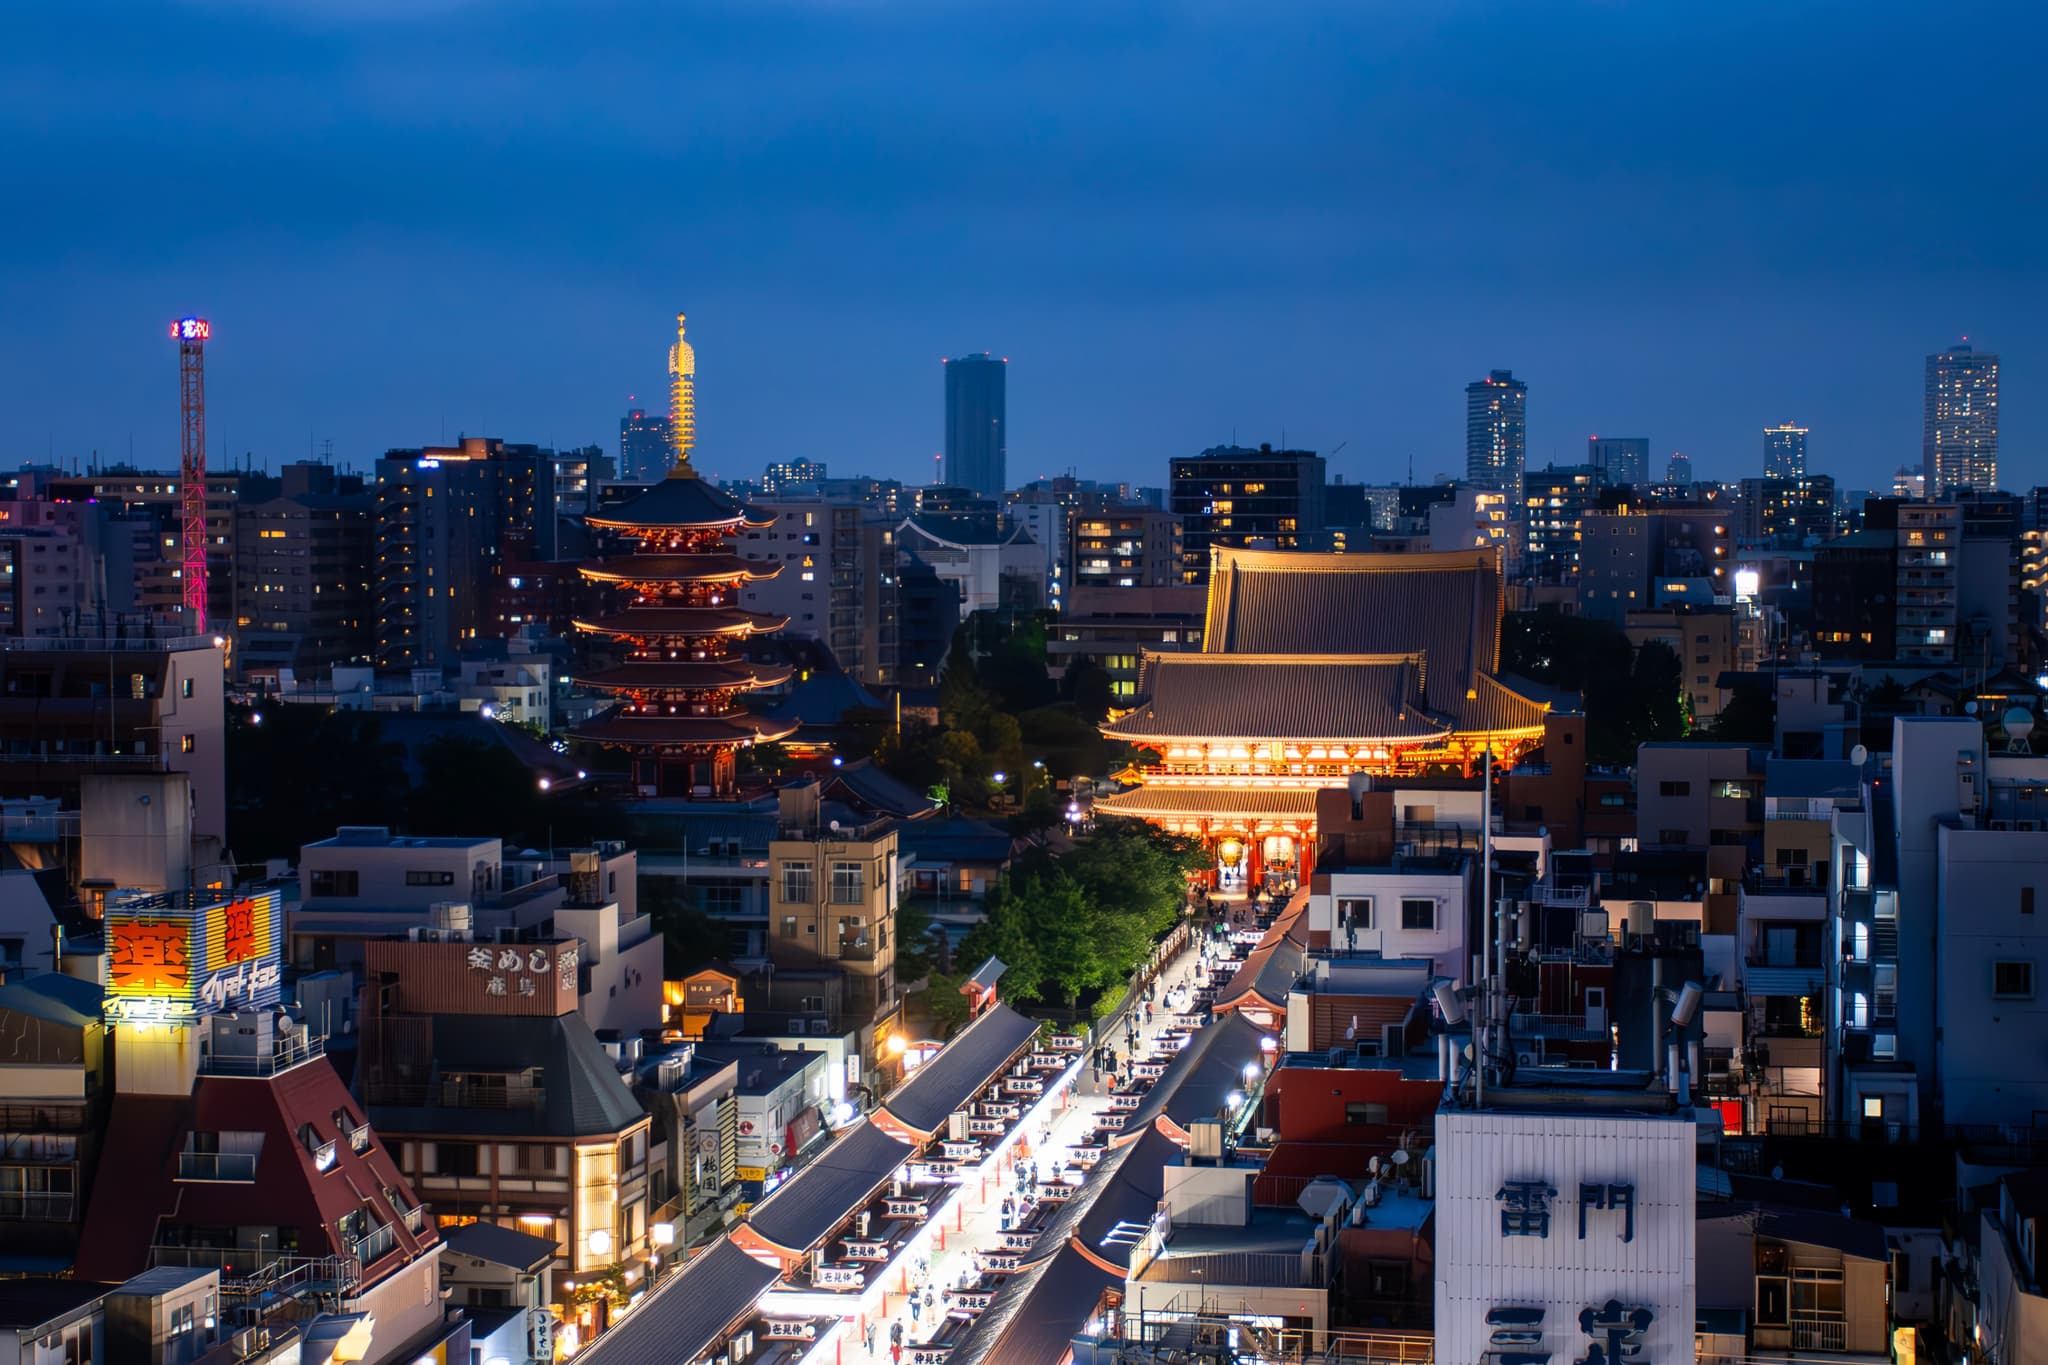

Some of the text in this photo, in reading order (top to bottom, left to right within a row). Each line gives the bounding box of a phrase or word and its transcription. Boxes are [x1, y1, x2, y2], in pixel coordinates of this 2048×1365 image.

[111, 921, 188, 989] 薬
[224, 897, 257, 963] 薬
[202, 960, 281, 1009] マツモトキヨシ
[1495, 1180, 1634, 1243] 雷門
